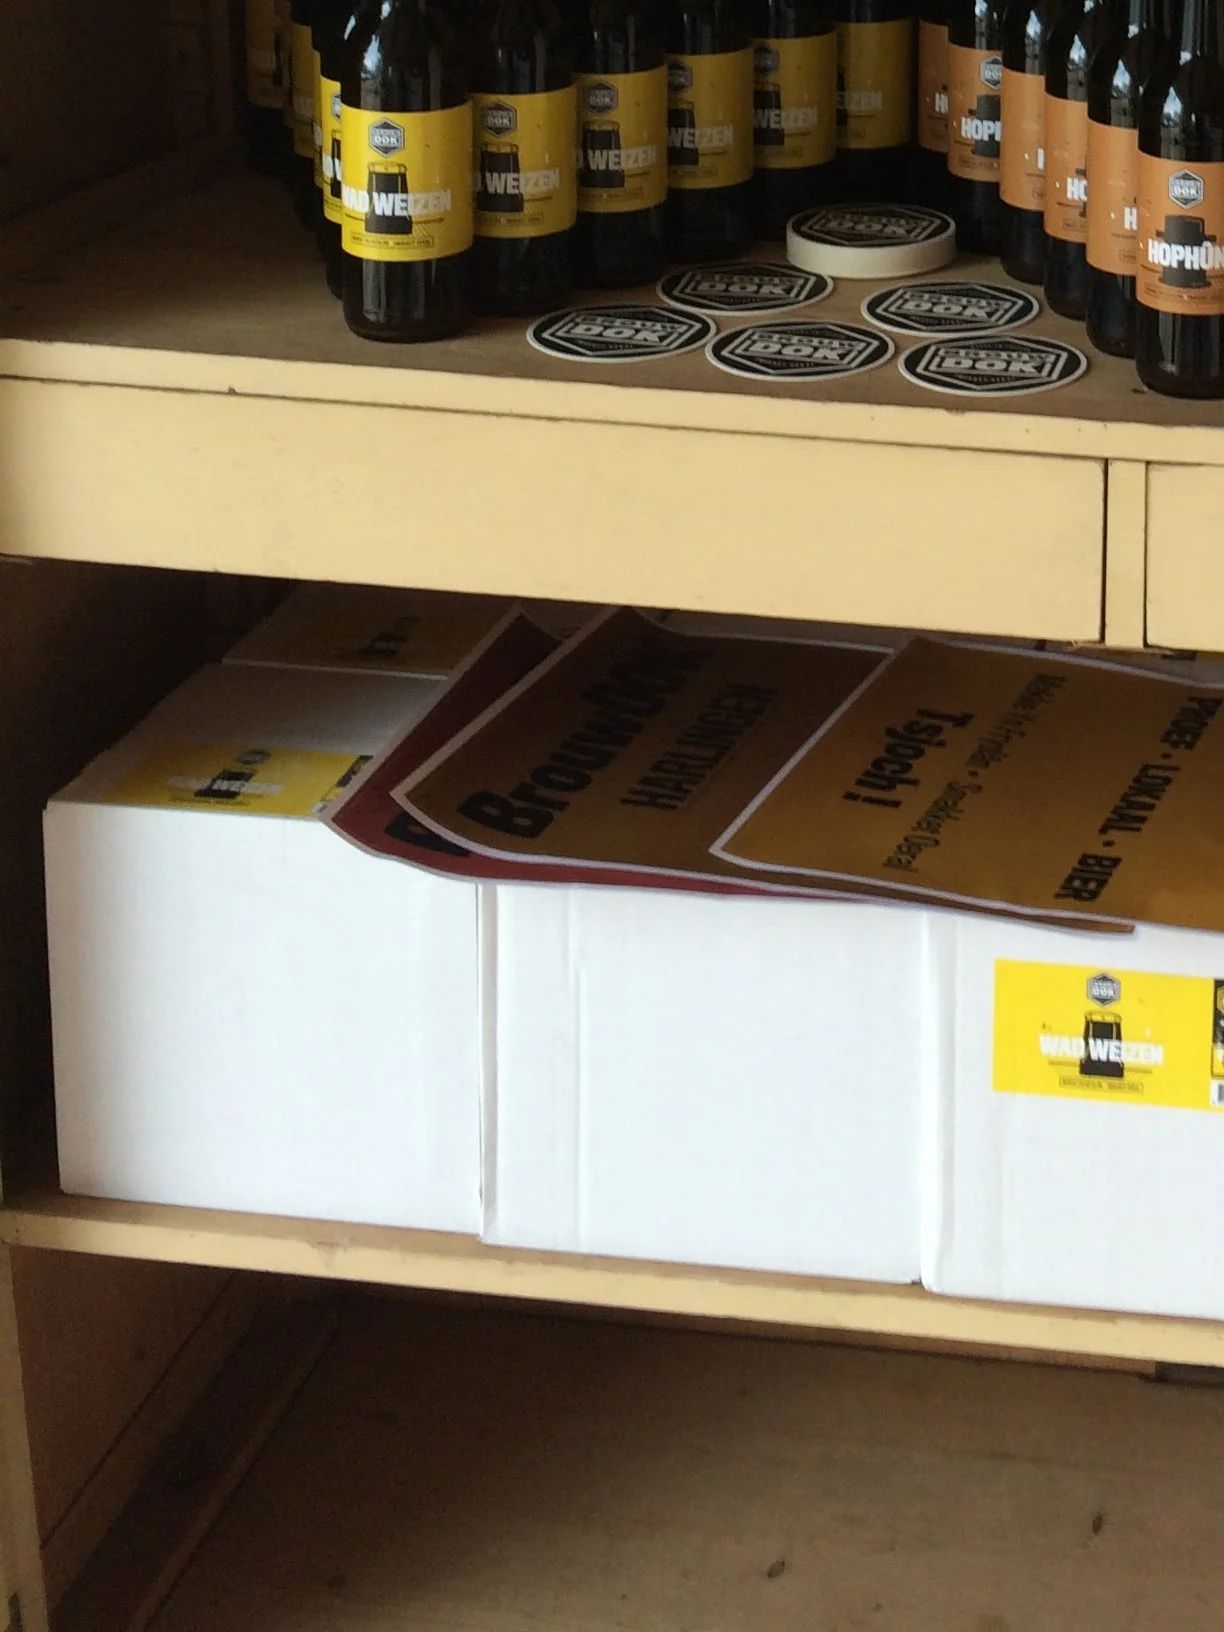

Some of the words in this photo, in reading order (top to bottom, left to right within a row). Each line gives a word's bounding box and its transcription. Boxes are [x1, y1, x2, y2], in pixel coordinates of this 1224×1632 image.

[901, 299, 996, 319] DOK
[570, 323, 675, 343] DOK
[748, 339, 850, 361] DOK
[942, 356, 1043, 375] DOK
[1053, 852, 1123, 902] BIER
